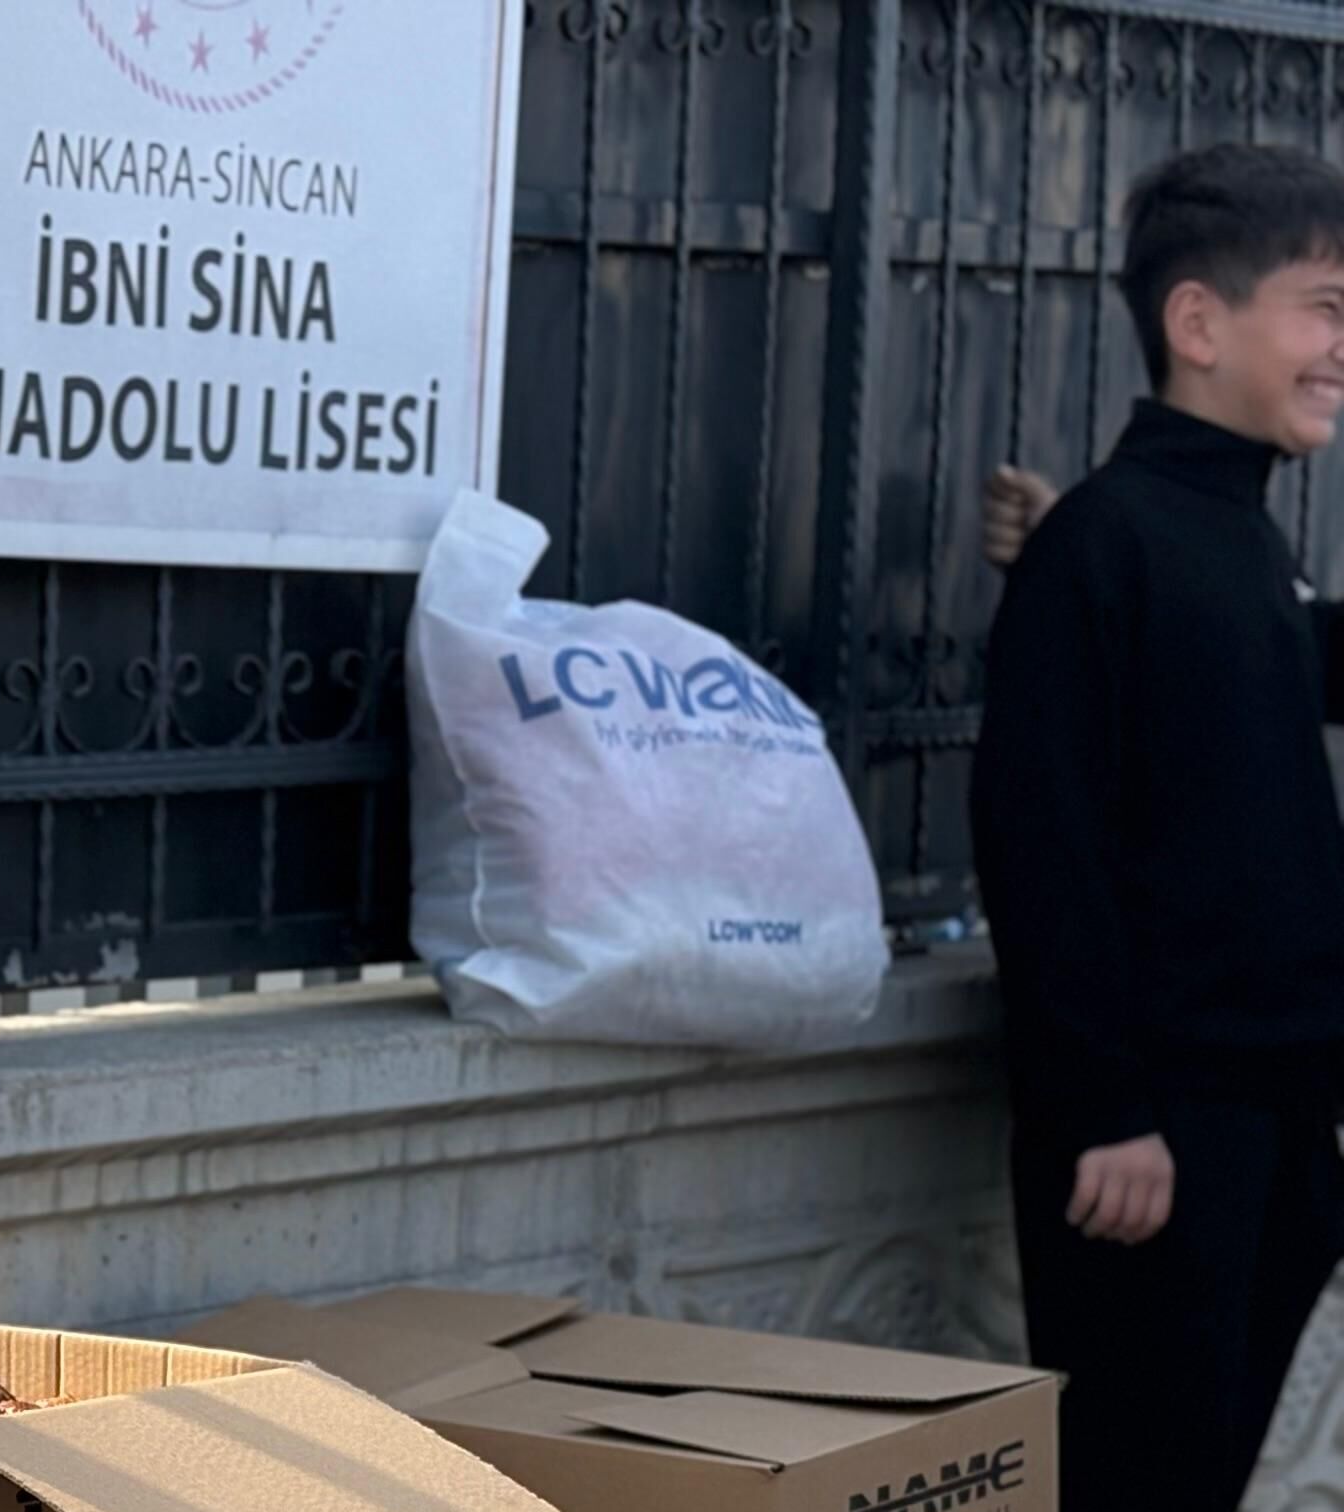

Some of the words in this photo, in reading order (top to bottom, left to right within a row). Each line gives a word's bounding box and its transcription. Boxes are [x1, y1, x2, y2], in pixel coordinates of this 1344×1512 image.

[24, 130, 358, 217] ANKARA-SİNCAN
[35, 215, 170, 328] İBNİ
[188, 233, 335, 343] SİNA
[259, 371, 439, 477] LİSESİ
[499, 647, 616, 722] LC
